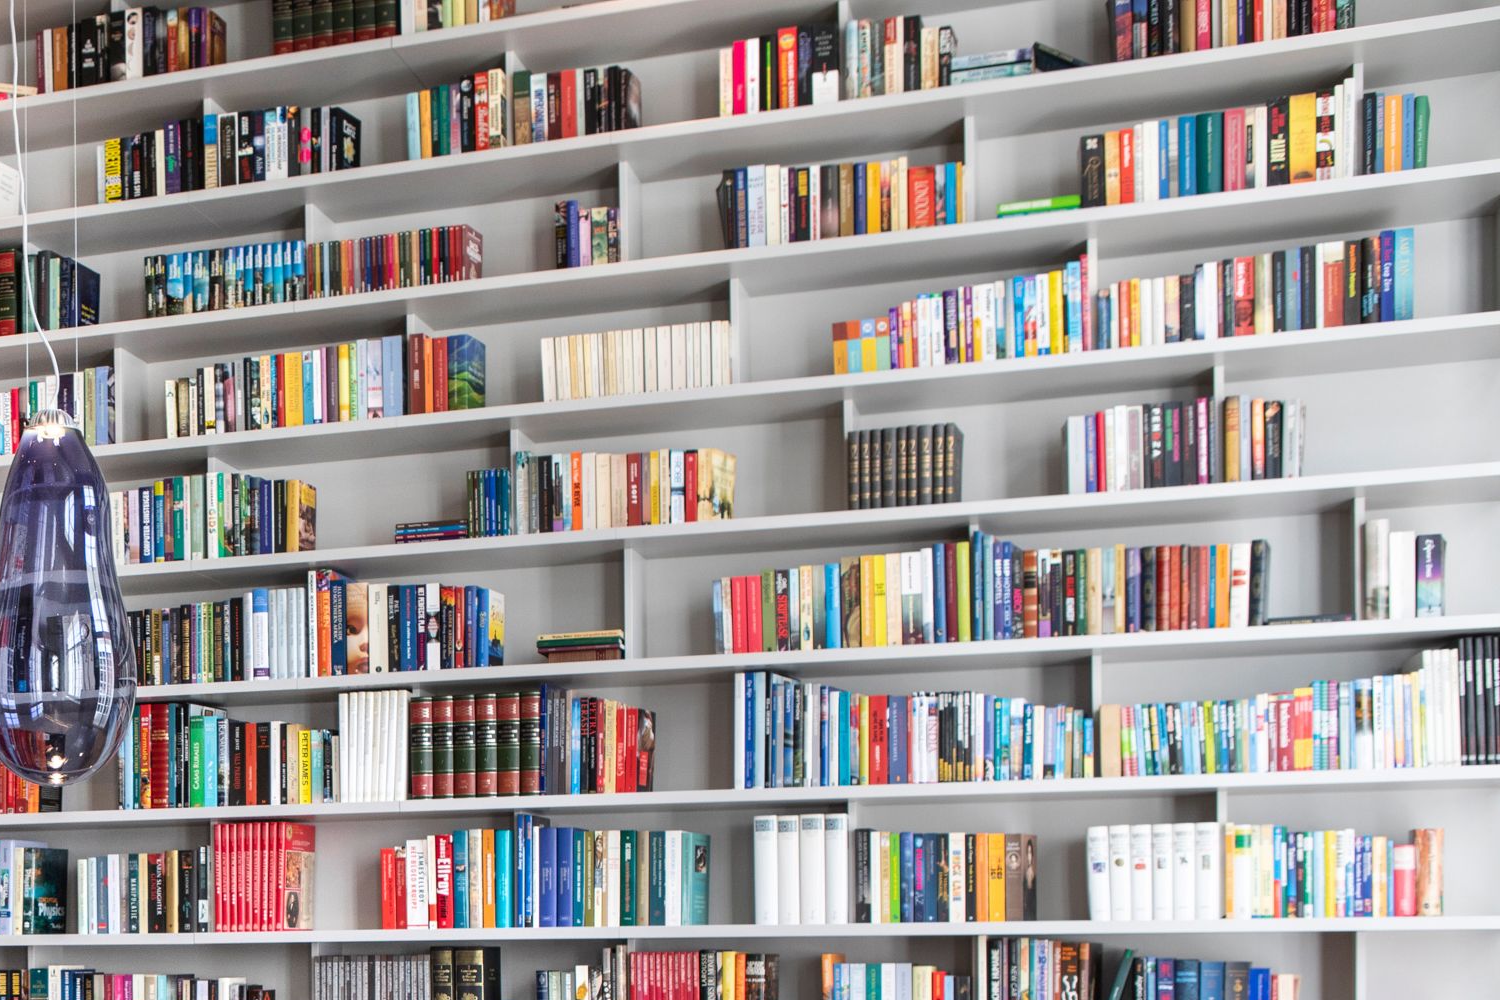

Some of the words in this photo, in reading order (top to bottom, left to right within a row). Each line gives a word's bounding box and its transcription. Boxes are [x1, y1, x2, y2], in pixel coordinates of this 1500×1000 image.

[1321, 116, 1330, 135] WELSH
[105, 139, 121, 176] ROBERTO
[914, 180, 933, 220] LONDON
[756, 196, 764, 234] VERLIEFDE
[3, 393, 11, 426] GRAHAM
[630, 484, 638, 504] SOFT
[142, 491, 151, 556] COMPUTER-EINSTEIGER
[208, 508, 218, 534] GIDS
[333, 585, 338, 593] TO
[1003, 576, 1011, 604] HOTELS
[1013, 588, 1022, 613] MERCY
[777, 594, 788, 639] STRIPTEASE
[589, 701, 597, 735] PETRA
[1280, 703, 1290, 749] Indonesia
[928, 716, 938, 754] INDIA
[439, 838, 447, 859] James
[952, 850, 961, 876] BRICK
[437, 859, 451, 896] Ellroy
[38, 903, 65, 919] Physics
[130, 878, 138, 920] MANIPULATIE
[707, 953, 715, 977] MONDE
[0, 973, 7, 995] LUDLUM
[12, 973, 20, 995] LUDLUM
[707, 978, 715, 986] DU
